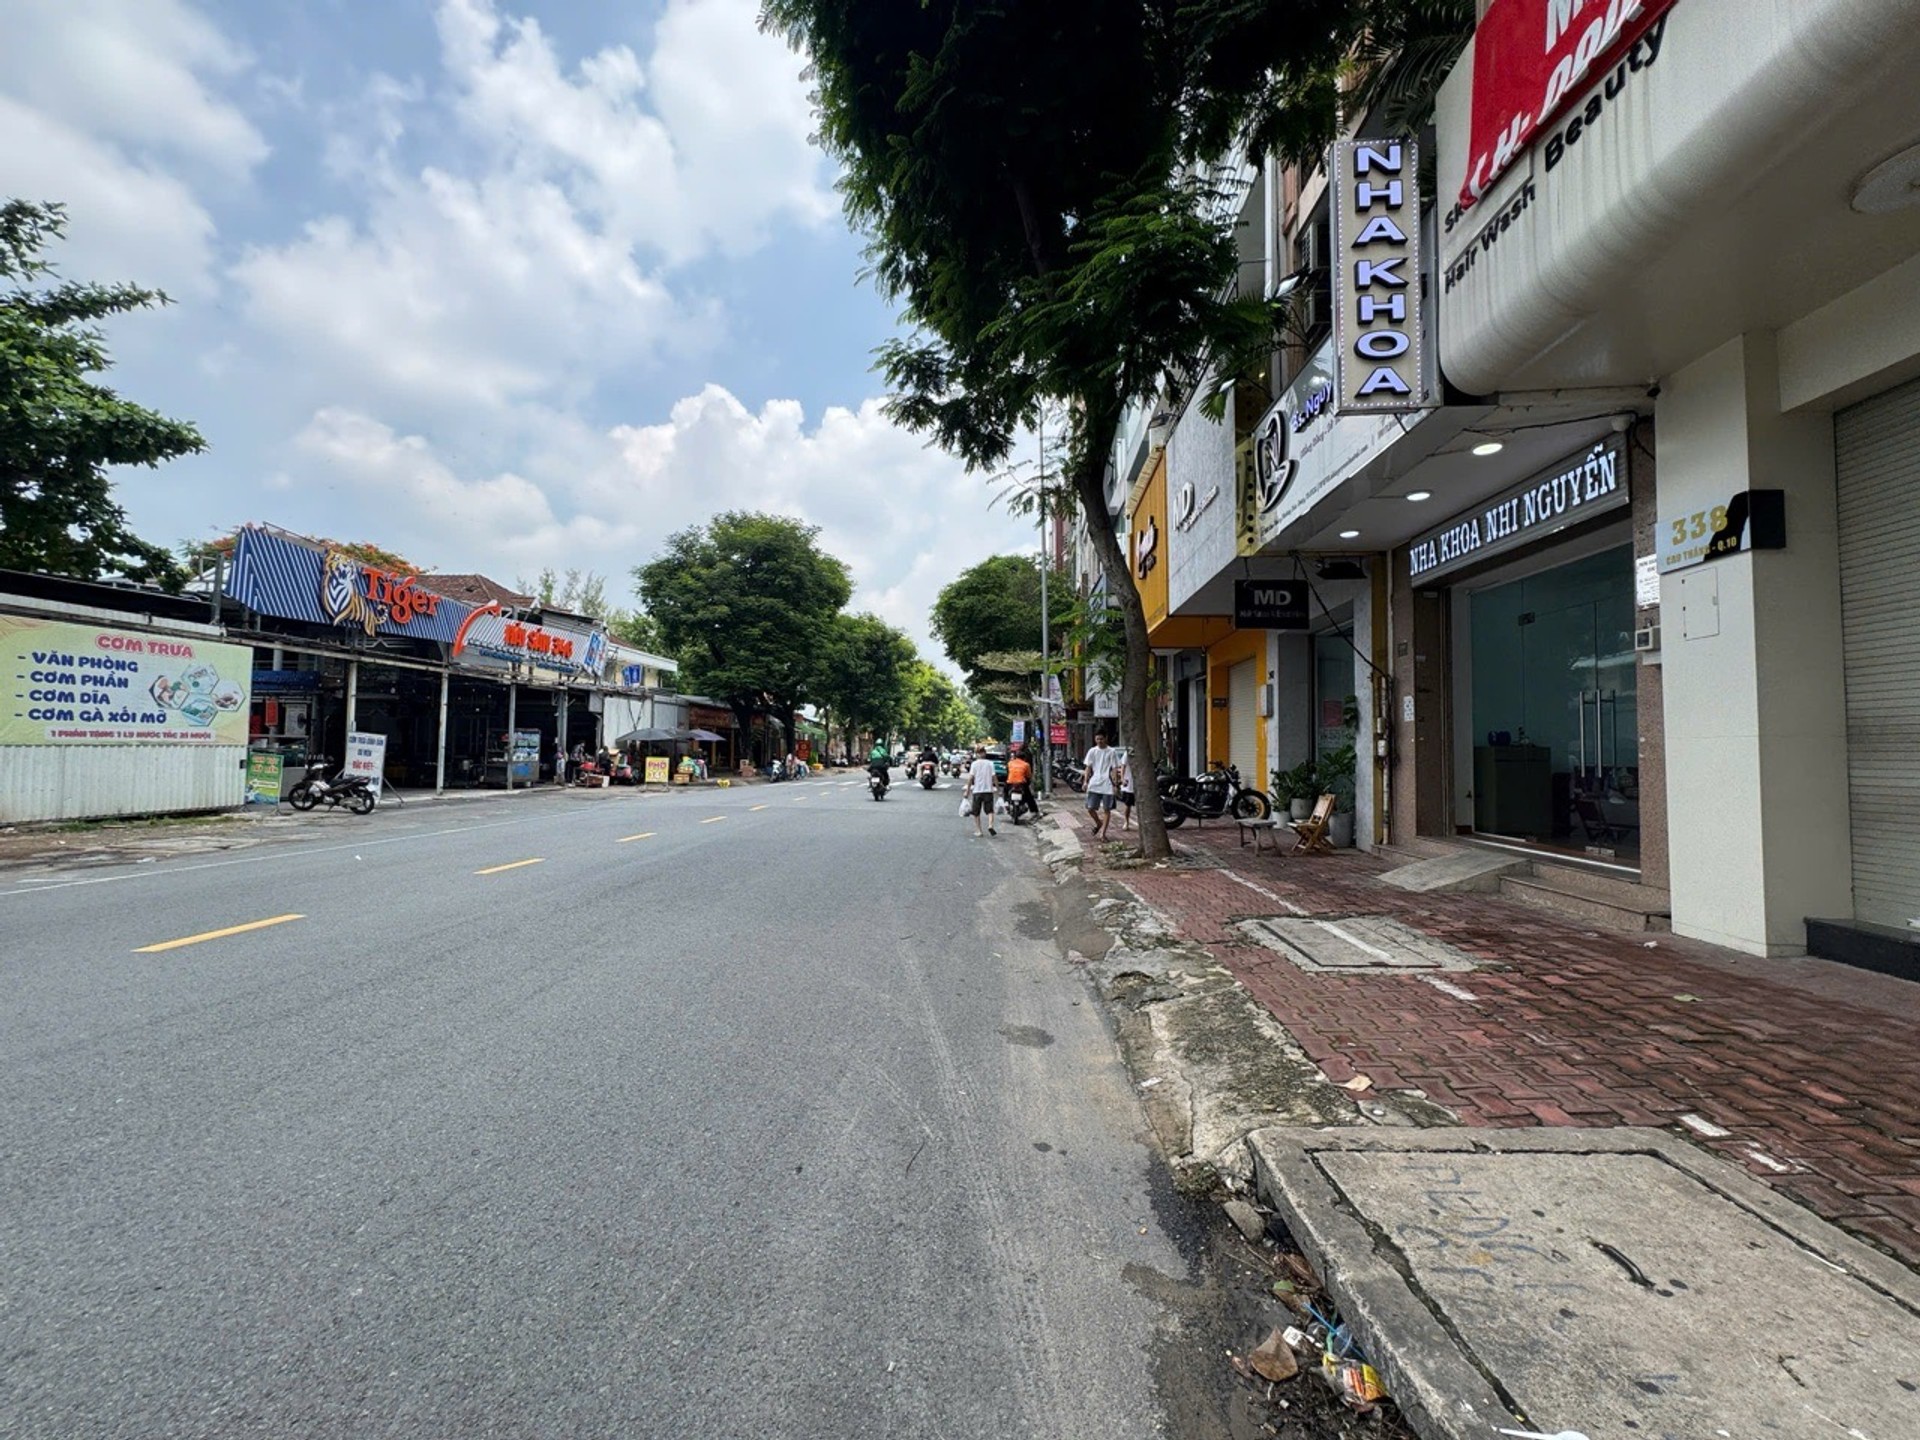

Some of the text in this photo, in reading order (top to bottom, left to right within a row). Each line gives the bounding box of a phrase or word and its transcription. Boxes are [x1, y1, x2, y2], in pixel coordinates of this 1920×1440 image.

[1545, 8, 1669, 173] Beauty
[1444, 247, 1477, 294] Hair
[1480, 183, 1536, 251] Wash
[1351, 144, 1411, 398] NHA KHOA
[1410, 442, 1617, 576] NHA KHOA NHI NGUYỄN
[1672, 505, 1728, 546] 338
[1717, 536, 1737, 551] Q.10
[362, 566, 442, 624] Tiger
[1254, 589, 1292, 605] MD
[96, 634, 194, 659] CƠM TRƯA
[32, 650, 74, 668] VĂN
[78, 654, 139, 673] PHÒNG
[30, 670, 76, 685] CƠM
[80, 670, 129, 689] PHẦN
[29, 689, 76, 704] CƠM
[79, 691, 111, 705] DĨA
[28, 708, 74, 722] CƠM
[79, 708, 104, 723] GÀ
[108, 706, 136, 723] XỐI
[140, 709, 167, 724] MỠ
